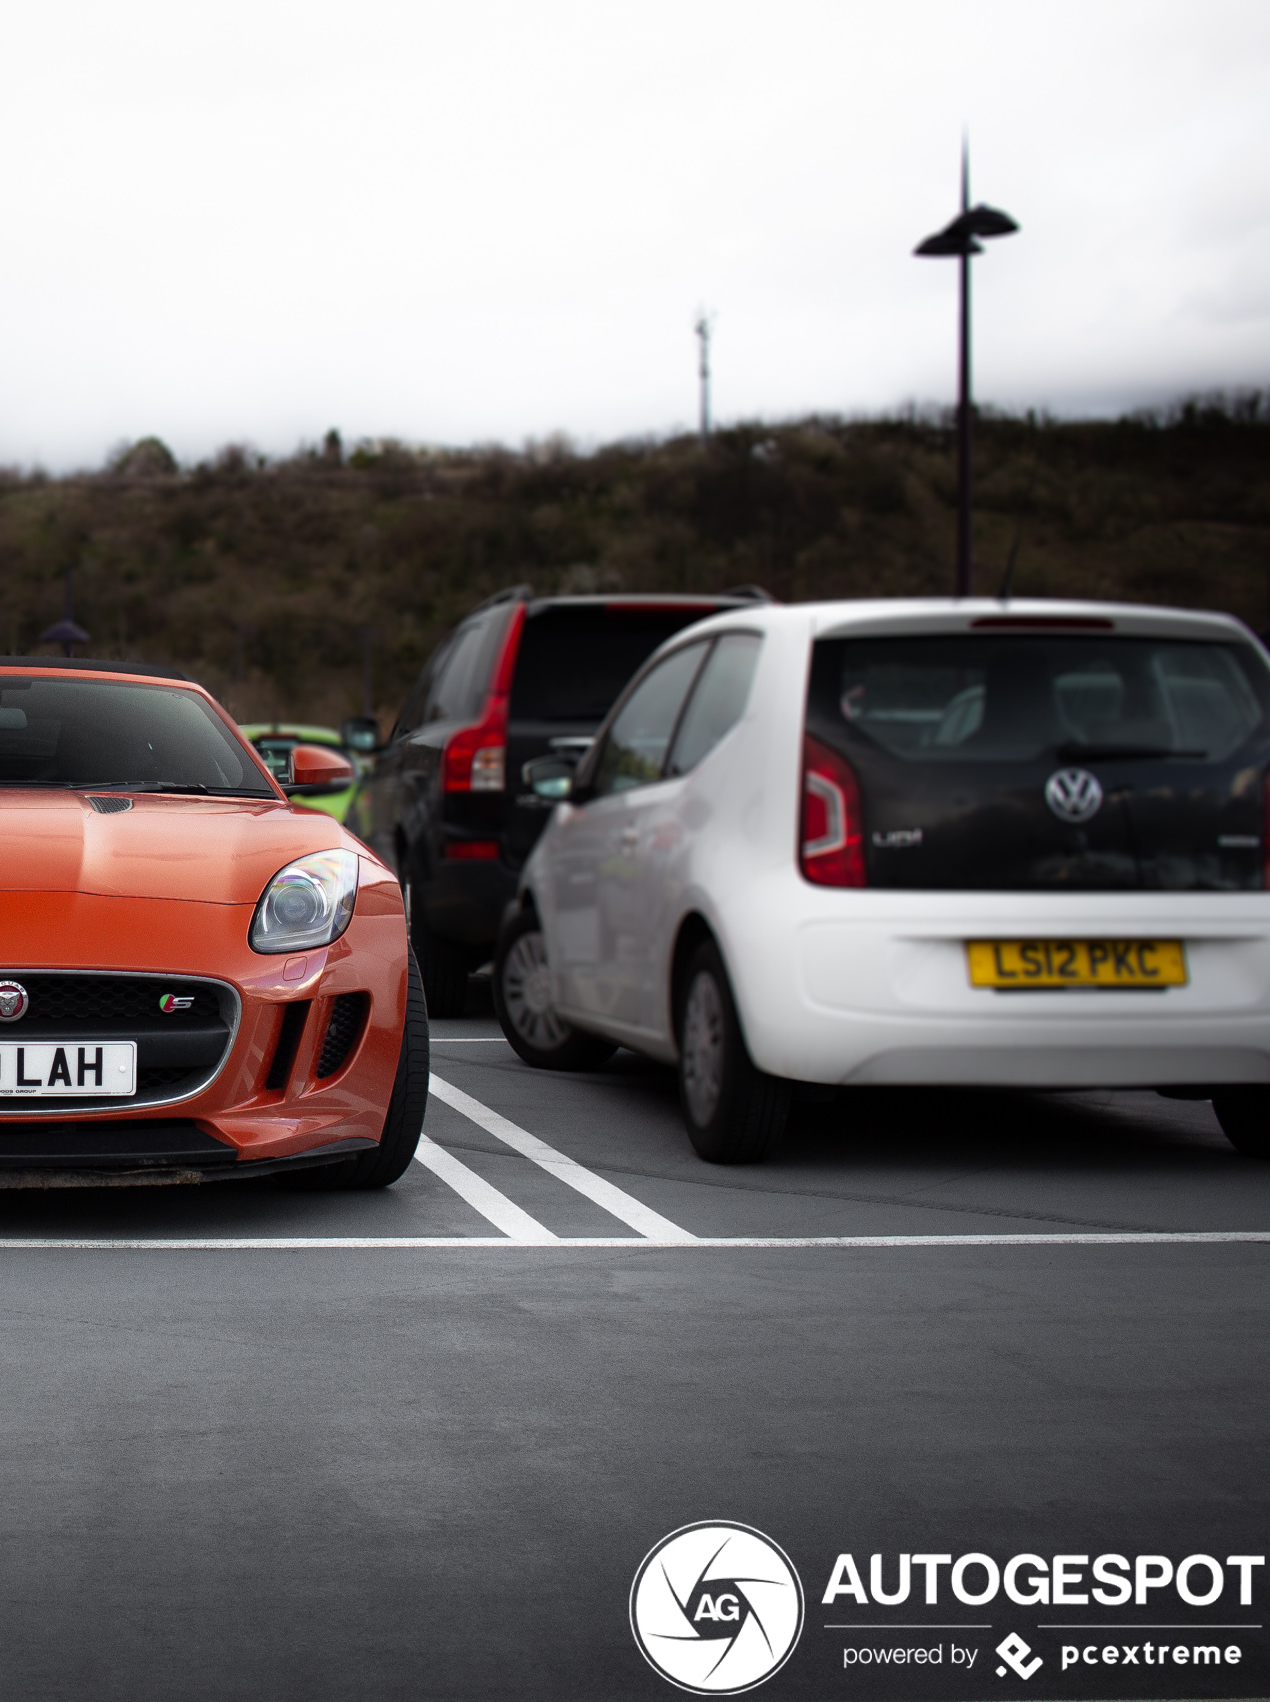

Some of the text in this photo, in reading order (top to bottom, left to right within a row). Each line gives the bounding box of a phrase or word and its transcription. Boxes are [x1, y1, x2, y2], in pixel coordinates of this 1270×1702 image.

[994, 942, 1160, 979] LS12 PKC
[16, 1047, 103, 1087] LAH
